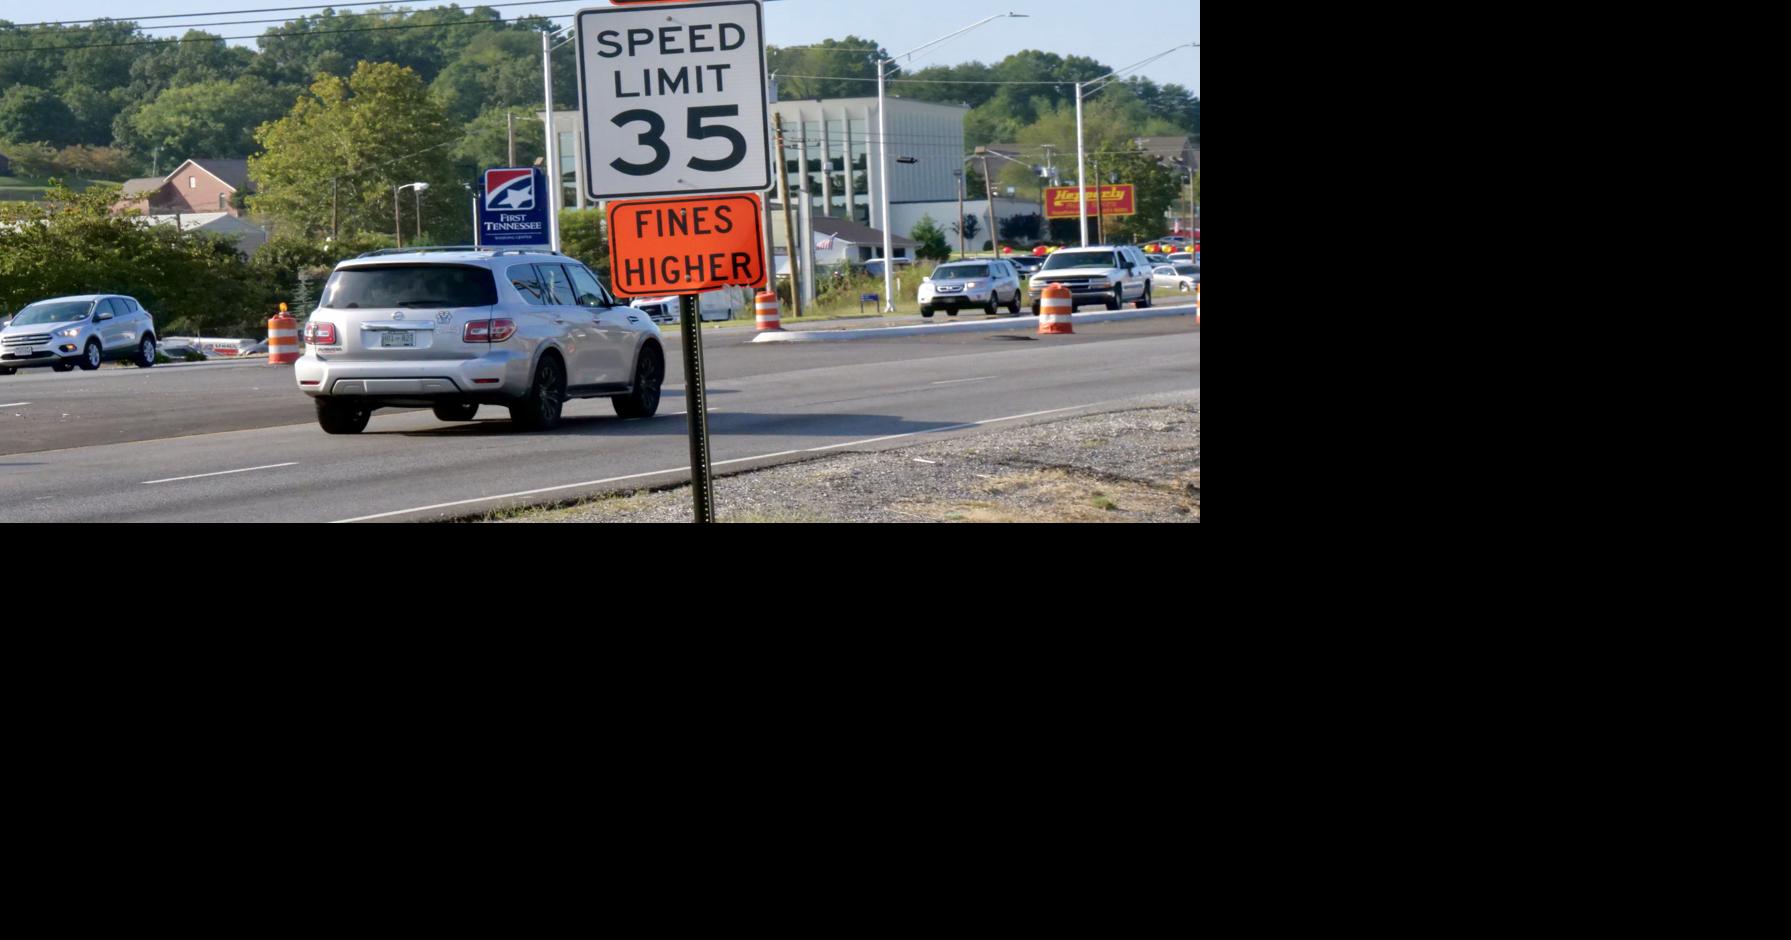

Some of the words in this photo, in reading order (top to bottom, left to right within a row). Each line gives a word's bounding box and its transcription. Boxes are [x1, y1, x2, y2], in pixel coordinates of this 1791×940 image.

[597, 22, 746, 58] SPEED
[614, 63, 731, 98] LIMIT
[609, 104, 747, 176] 35
[484, 221, 542, 231] TENNESSEE
[500, 213, 527, 222] FIRST
[635, 205, 733, 239] FINES
[624, 252, 752, 287] HIGHER
